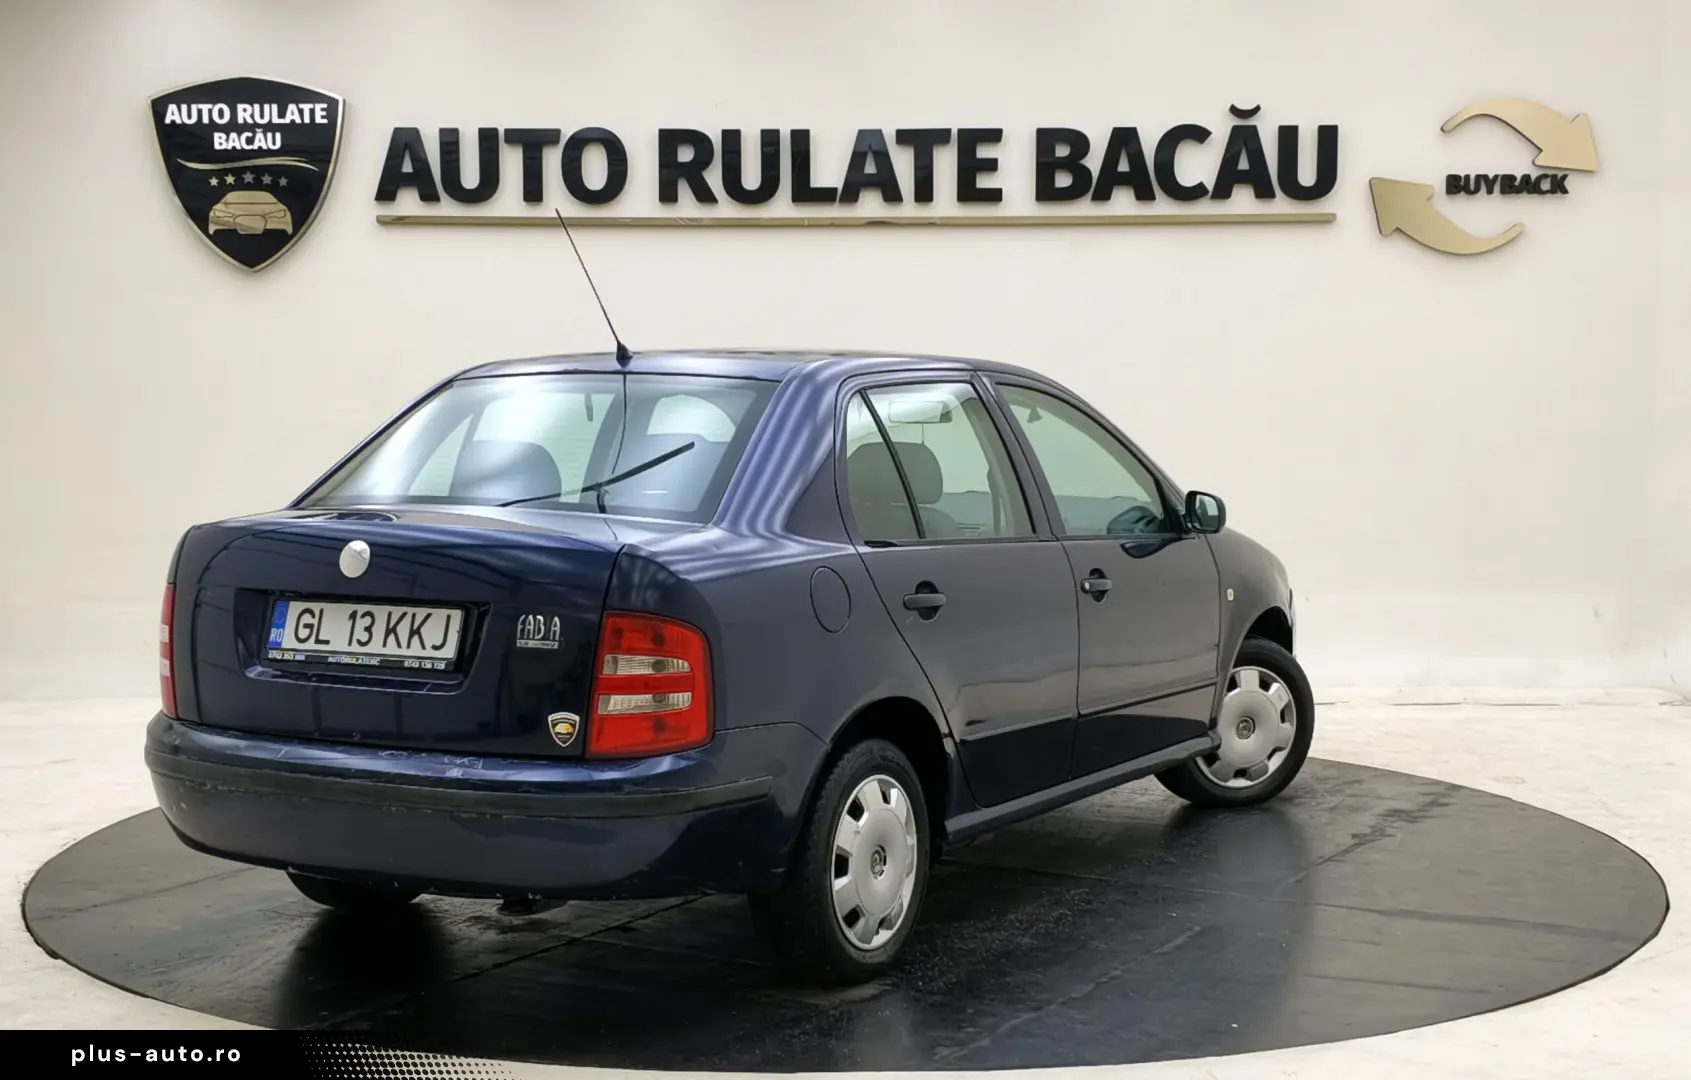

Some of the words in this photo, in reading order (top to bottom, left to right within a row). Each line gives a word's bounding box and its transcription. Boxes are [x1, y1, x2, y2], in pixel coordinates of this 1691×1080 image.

[165, 103, 230, 125] AUTO
[237, 103, 328, 124] RULATE
[213, 129, 281, 150] BACĂU
[374, 127, 629, 204] AUTO
[658, 128, 1003, 204] RULATE
[1035, 104, 1339, 201] BACĂU
[1445, 173, 1569, 195] BUYBACK
[269, 627, 284, 643] RO
[294, 608, 330, 644] GL
[348, 610, 375, 647] 13
[382, 610, 451, 651] KKJ
